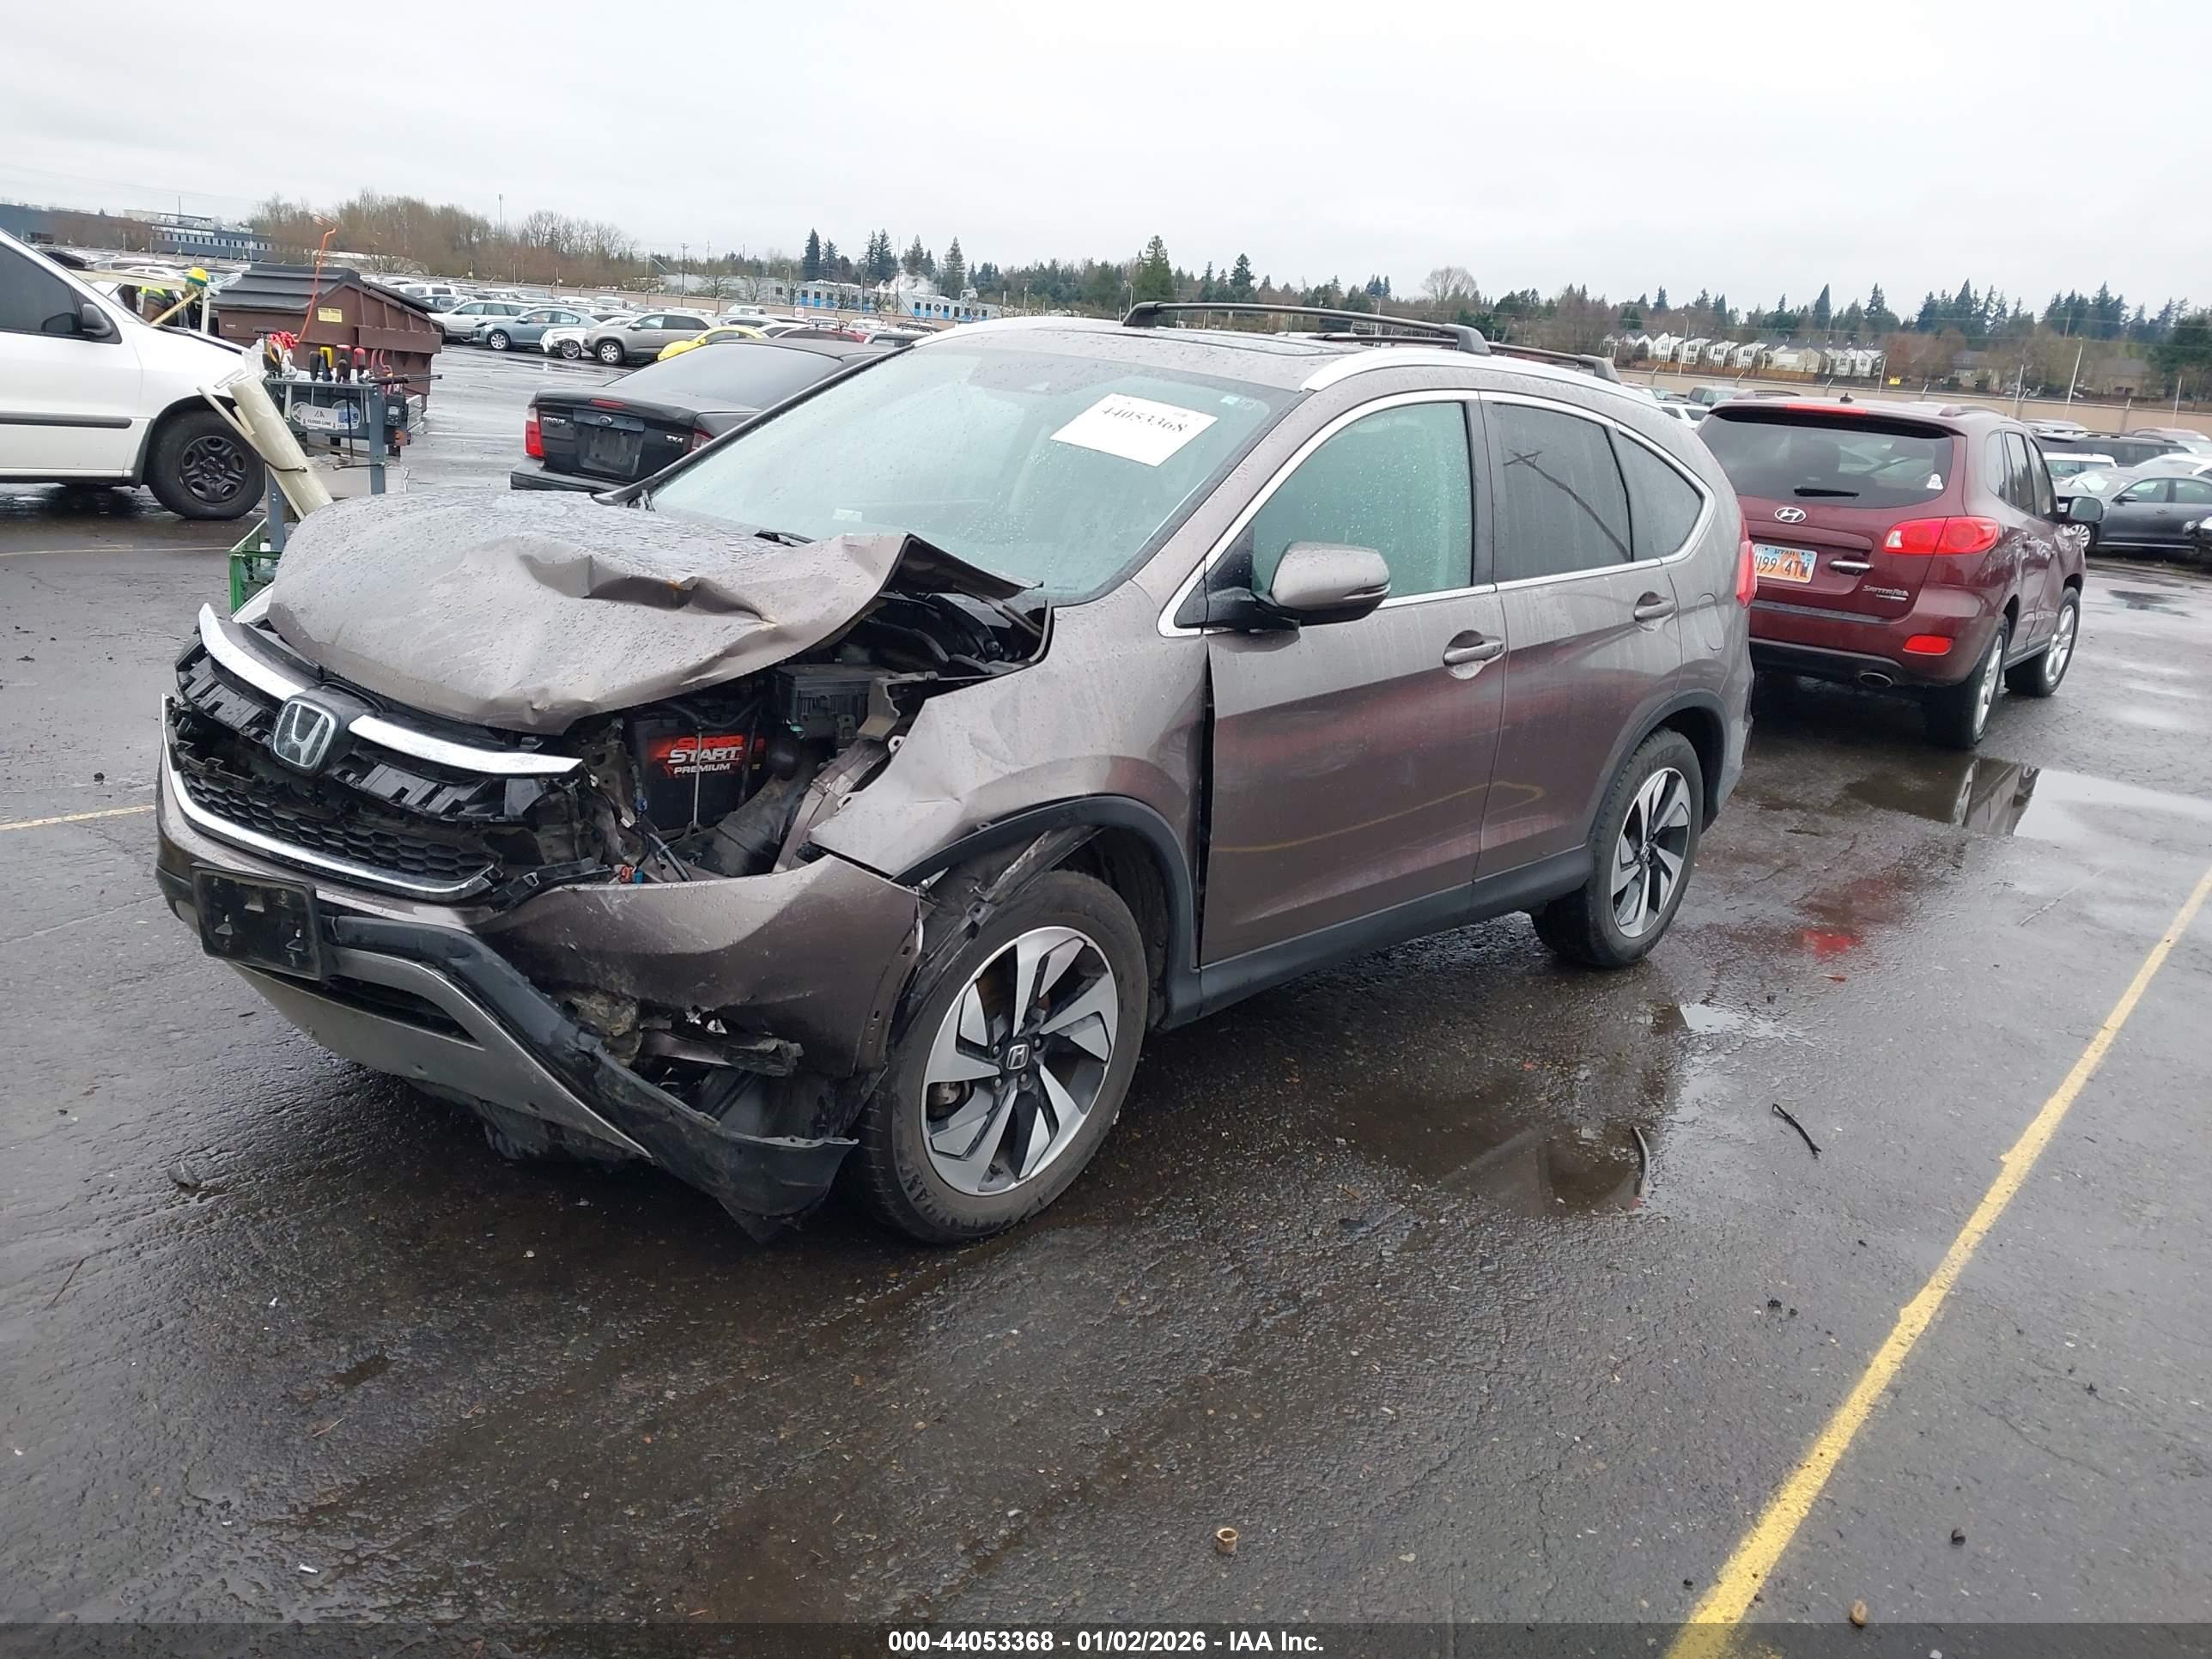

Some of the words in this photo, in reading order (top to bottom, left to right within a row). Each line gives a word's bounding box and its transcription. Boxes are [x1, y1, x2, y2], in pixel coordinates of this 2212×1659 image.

[543, 416, 566, 425] FOCUS
[678, 736, 743, 749] SUPER
[667, 746, 744, 764] START
[673, 763, 731, 775] PREMIUM
